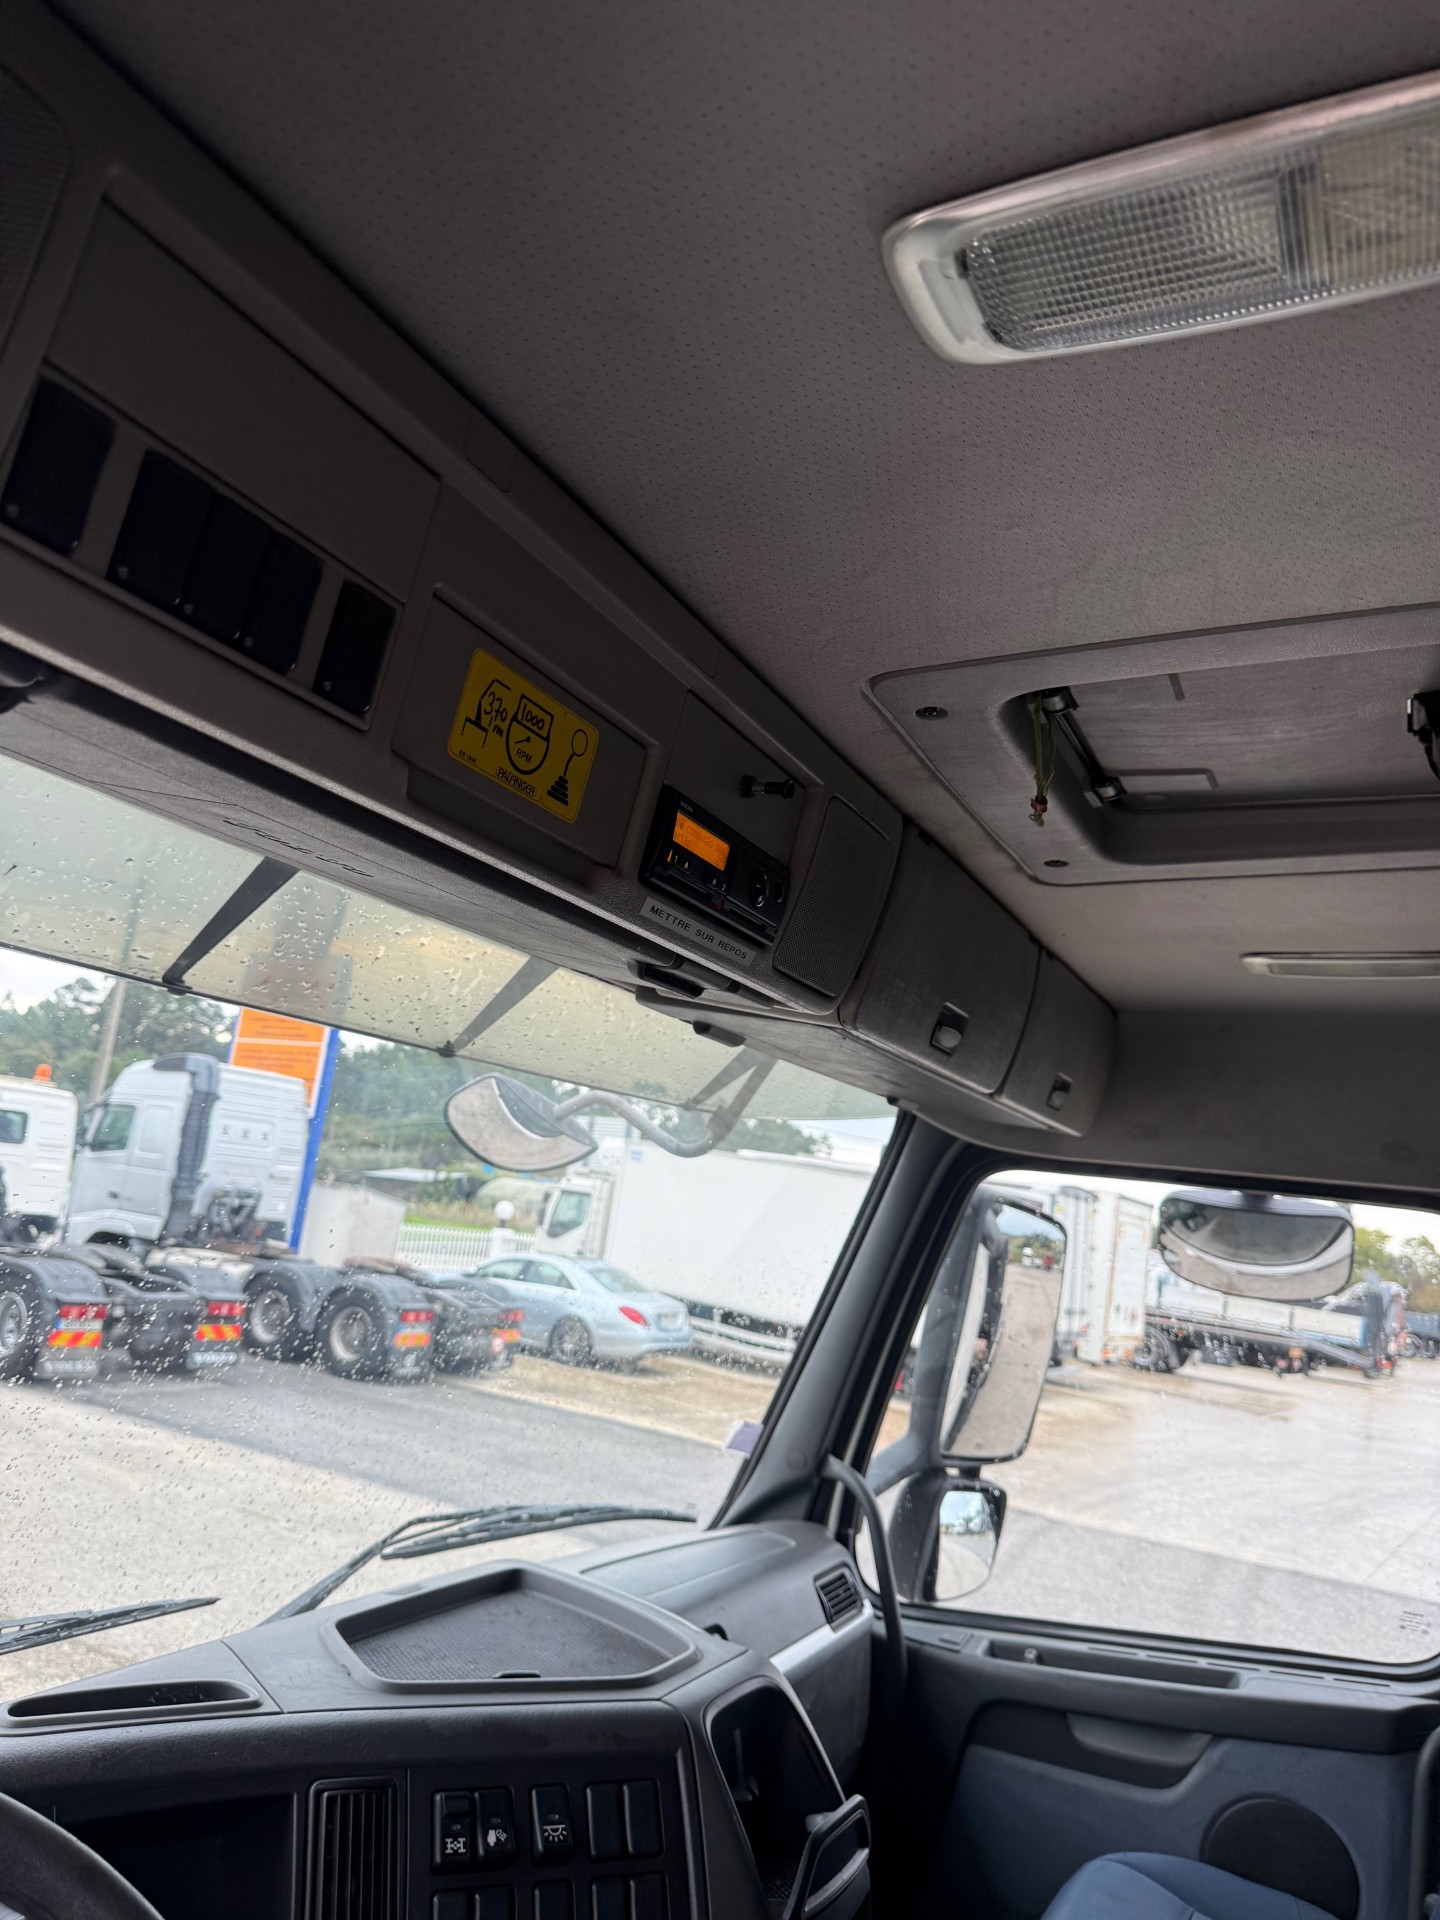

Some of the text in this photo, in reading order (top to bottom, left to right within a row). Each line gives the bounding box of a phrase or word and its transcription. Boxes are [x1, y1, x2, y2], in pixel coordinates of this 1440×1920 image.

[521, 702, 545, 731] 1000
[516, 748, 533, 764] RPM
[497, 767, 536, 796] PALFINGER
[650, 905, 747, 959] METTRE SUR REPOS
